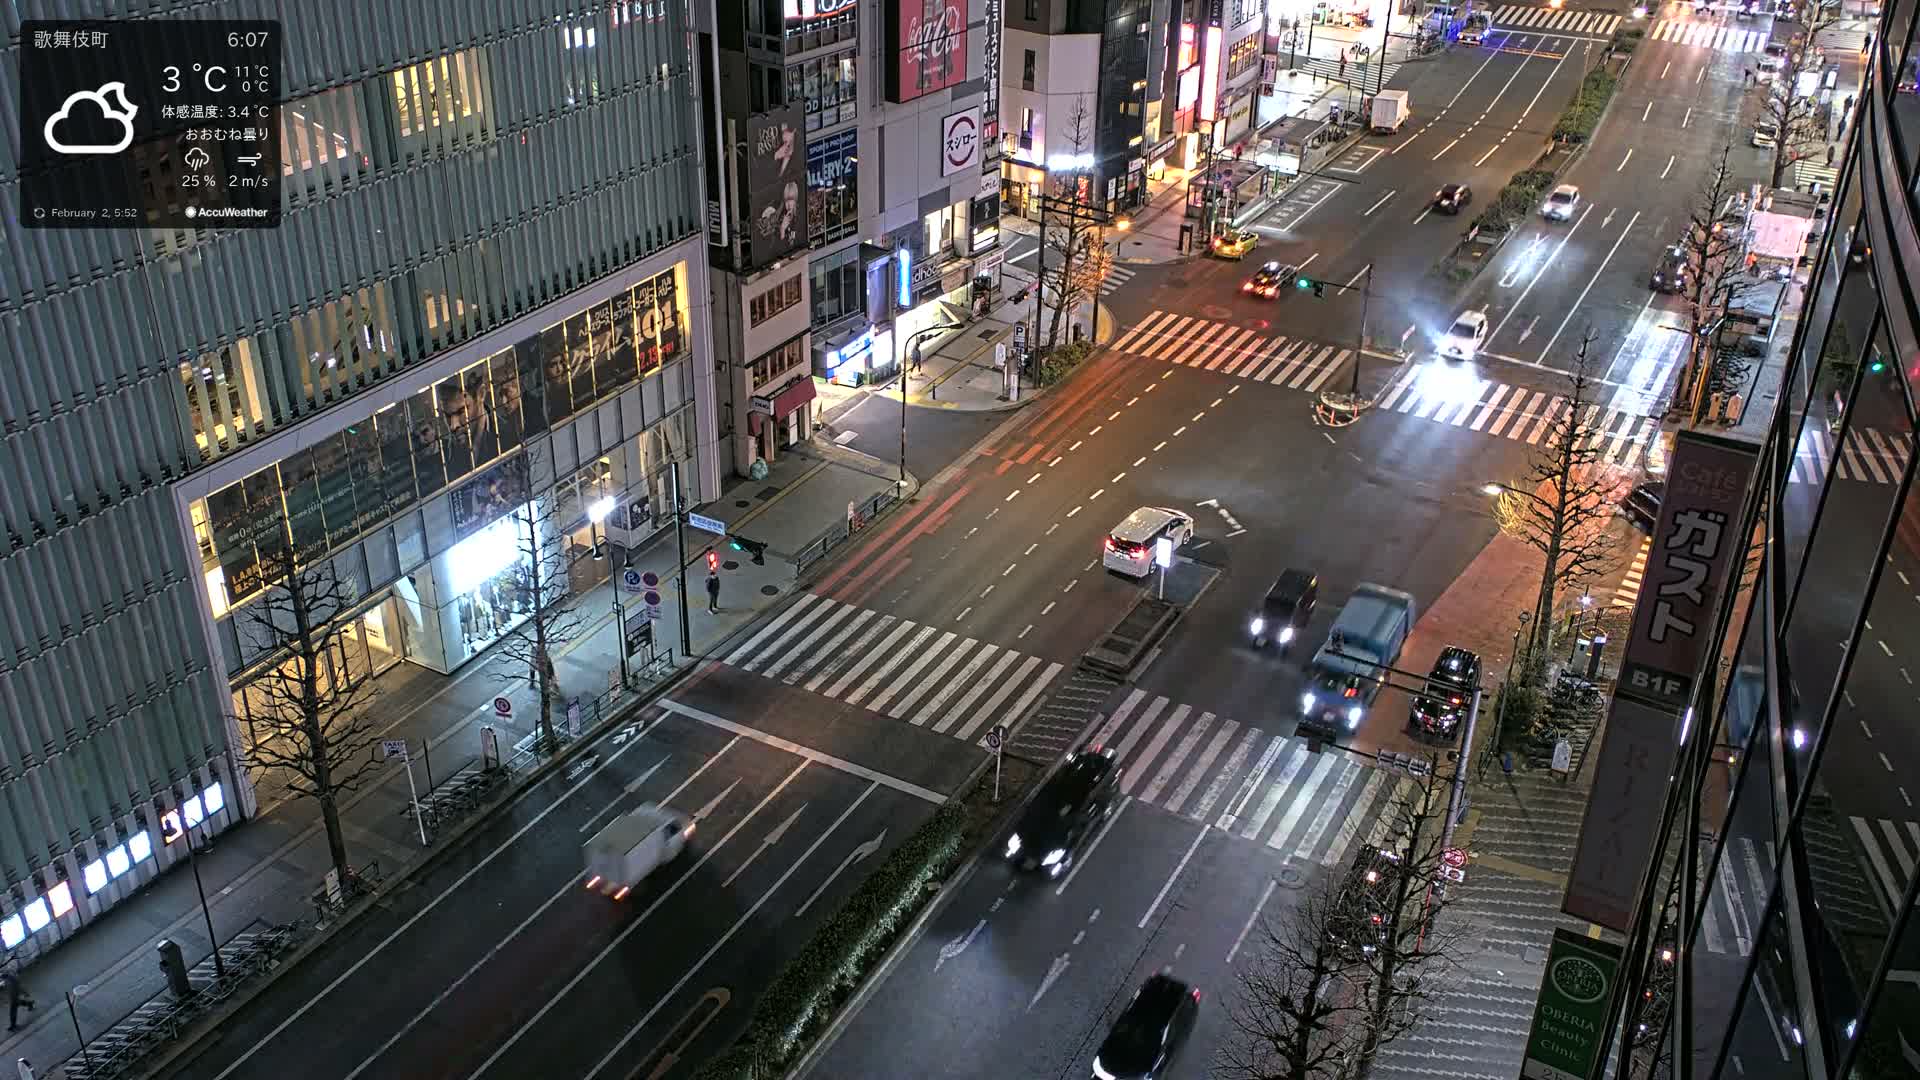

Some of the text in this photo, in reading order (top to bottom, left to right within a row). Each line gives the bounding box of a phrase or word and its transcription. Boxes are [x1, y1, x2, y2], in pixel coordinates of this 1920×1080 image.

[946, 134, 977, 152] スシロー
[708, 200, 720, 234] MUJI
[1015, 326, 1024, 336] P
[1650, 509, 1727, 643] ガスト
[1631, 669, 1681, 696] B1F
[1541, 1004, 1595, 1033] OBERIA
[1541, 1020, 1591, 1047] Beauty
[1540, 1039, 1581, 1061] Clinic
